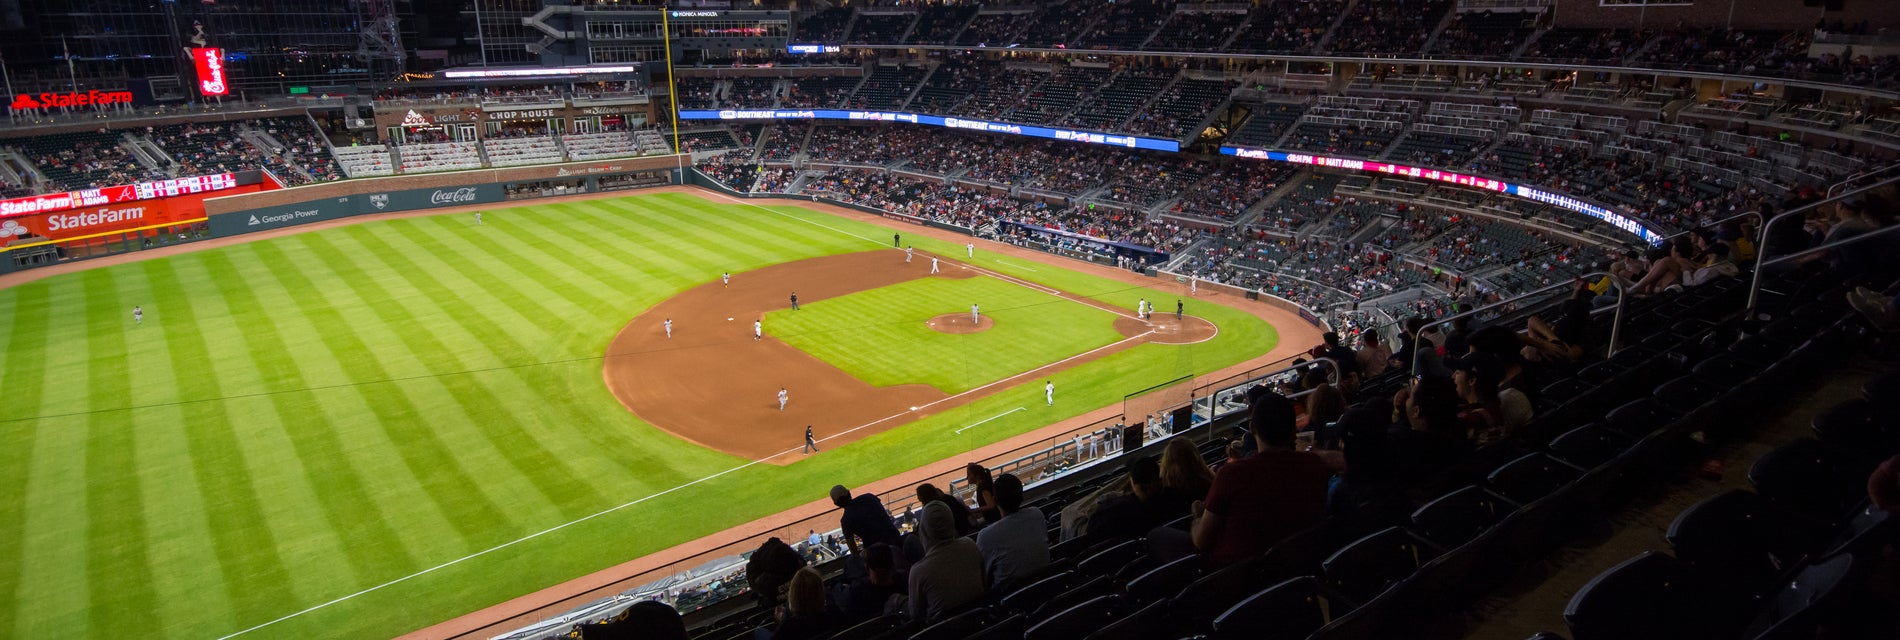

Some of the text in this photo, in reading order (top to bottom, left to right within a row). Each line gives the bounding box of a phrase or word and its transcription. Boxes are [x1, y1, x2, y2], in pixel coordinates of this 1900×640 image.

[433, 114, 460, 122] LIGHT
[489, 109, 554, 119] CHOP HOUSE
[1325, 157, 1342, 167] MATT
[1342, 159, 1363, 169] ADAMS
[81, 189, 101, 198] MATT
[83, 196, 109, 205] ADAMS
[261, 208, 319, 224] Georgia Power
